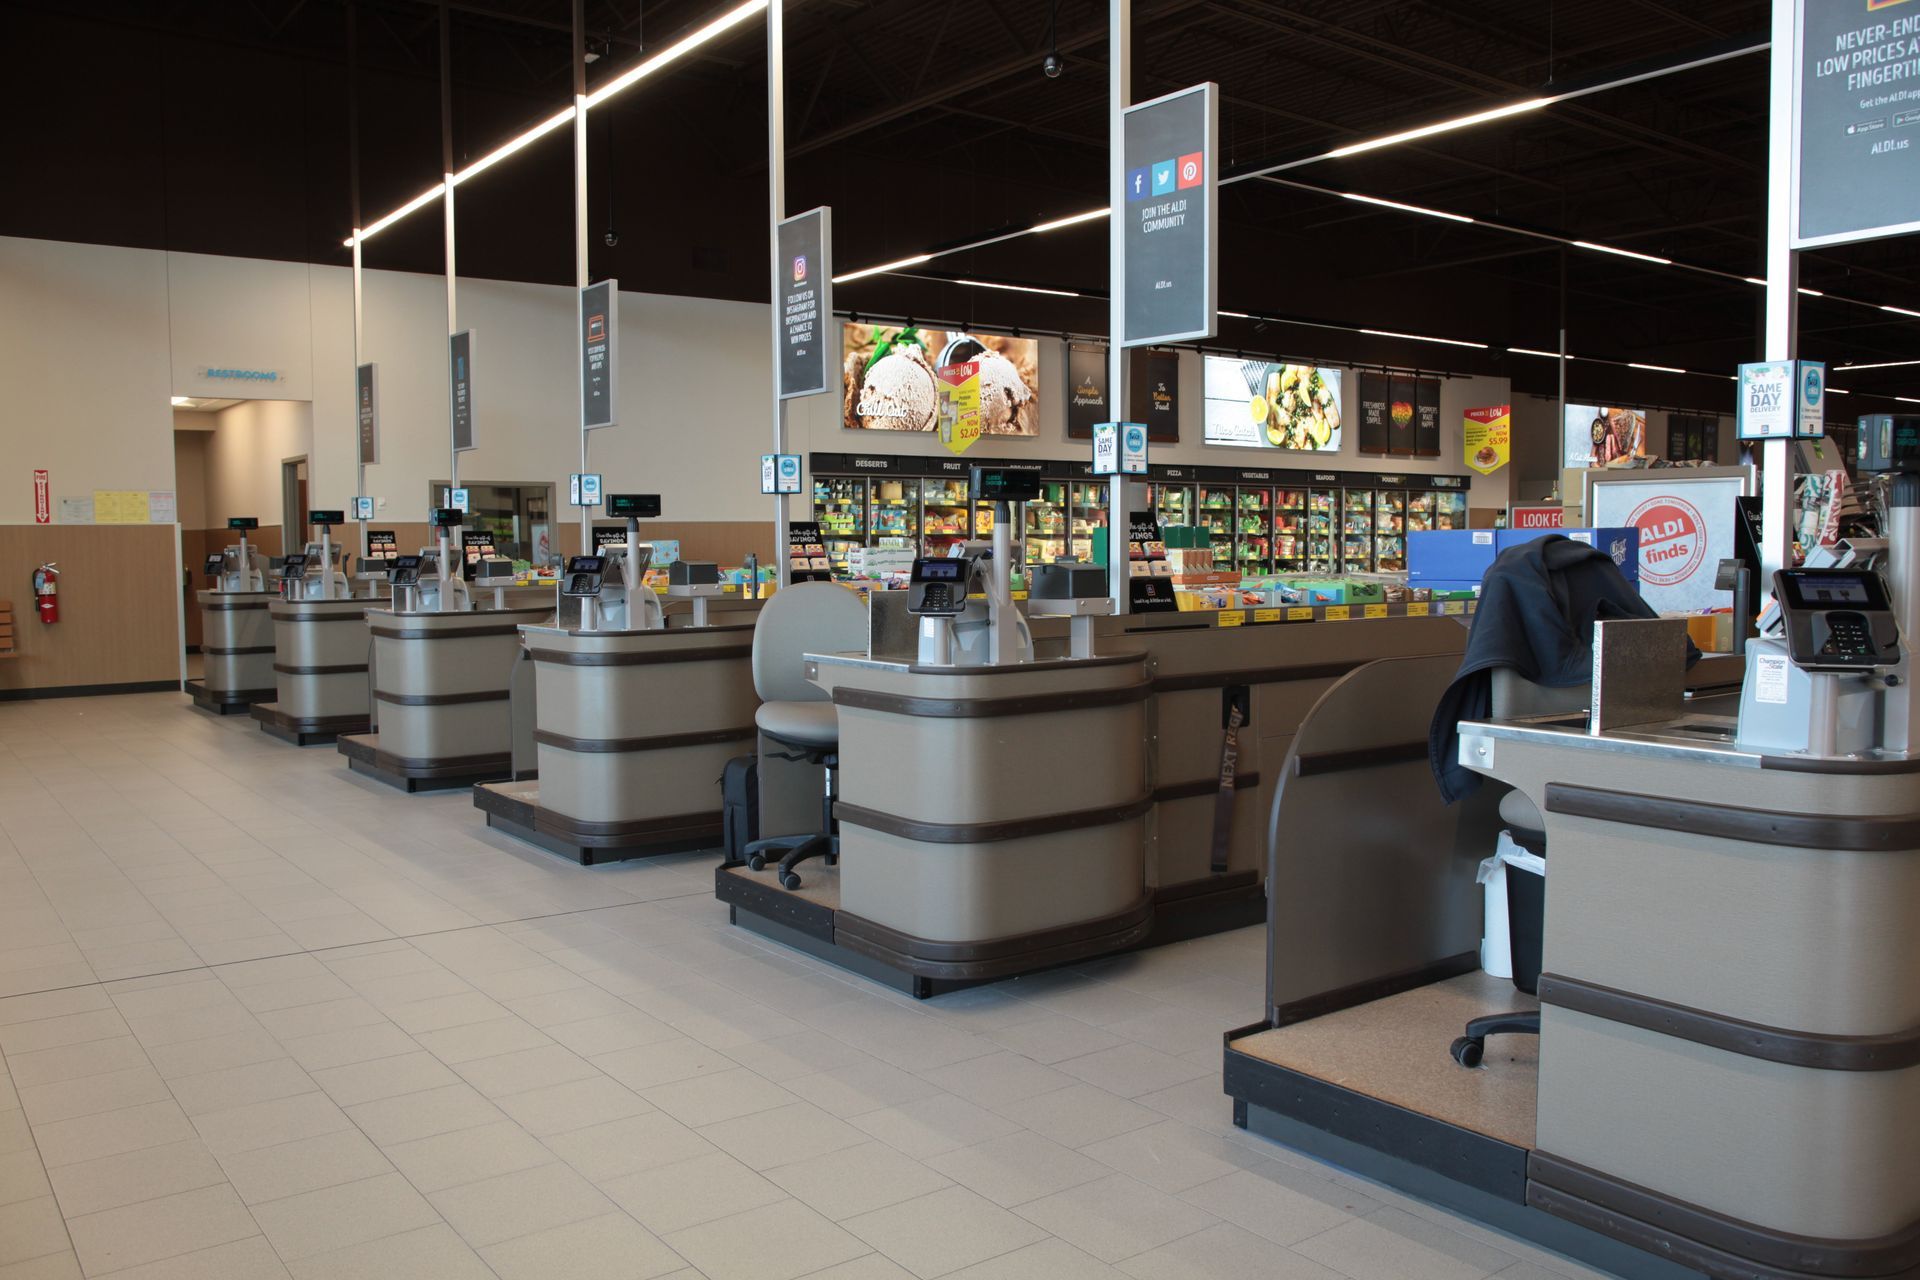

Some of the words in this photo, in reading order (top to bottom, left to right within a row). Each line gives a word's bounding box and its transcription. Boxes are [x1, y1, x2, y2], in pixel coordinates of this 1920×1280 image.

[1817, 54, 1849, 78] LOW
[1852, 40, 1905, 69] PRICES
[1908, 36, 1920, 56] A
[1848, 58, 1920, 91] FINGERTI
[1860, 98, 1874, 109] Get
[1875, 95, 1888, 106] the
[1889, 90, 1908, 103] ALDI
[1871, 139, 1909, 155] ALDI.us
[1142, 204, 1157, 222] JOIN
[1157, 202, 1171, 218] THE
[1171, 199, 1187, 215] ALDI
[1143, 214, 1186, 233] COMMUNITY
[787, 293, 802, 305] FOLLOW
[207, 368, 277, 382] RESTROOMS
[960, 364, 972, 377] LOW
[1084, 376, 1091, 384] A
[1751, 383, 1782, 394] SAME
[1073, 395, 1104, 406] Approach
[1362, 401, 1385, 410] FRESHNESS
[1751, 393, 1781, 407] DAY
[1490, 408, 1502, 417] LOW
[960, 428, 978, 439] $2.49
[1489, 437, 1507, 445] $5.99
[1098, 444, 1112, 453] DAY
[855, 460, 888, 469] DESSERTS
[943, 462, 961, 470] FRUIT
[1523, 513, 1550, 527] LOOK
[1640, 518, 1685, 544] ALDI
[1645, 543, 1688, 564] finds
[1221, 748, 1237, 788] NEXT
